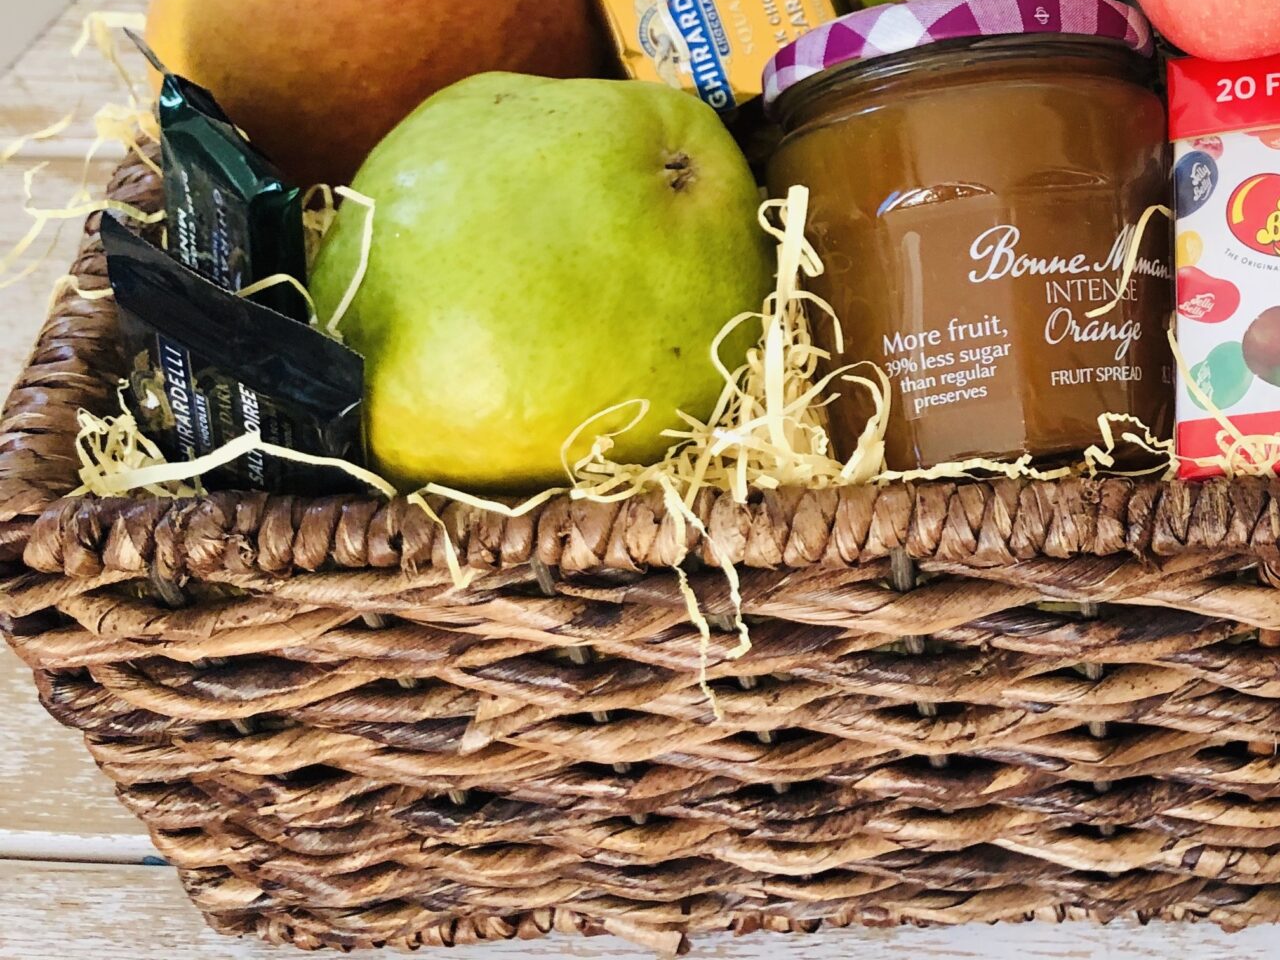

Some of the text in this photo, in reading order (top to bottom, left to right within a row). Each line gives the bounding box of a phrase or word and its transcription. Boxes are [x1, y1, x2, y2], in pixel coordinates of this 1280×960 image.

[1214, 75, 1257, 103] 20
[968, 224, 1172, 284] Bonne Mman
[1045, 278, 1139, 305] INTENSE
[883, 314, 1009, 356] More fruit,
[1044, 307, 1143, 361] Orange
[920, 352, 955, 370] less
[959, 343, 1012, 365] sugar
[900, 364, 998, 394] than regular
[1051, 369, 1092, 386] FRUIT
[1095, 366, 1142, 384] SPREAD
[913, 385, 988, 414] preserves
